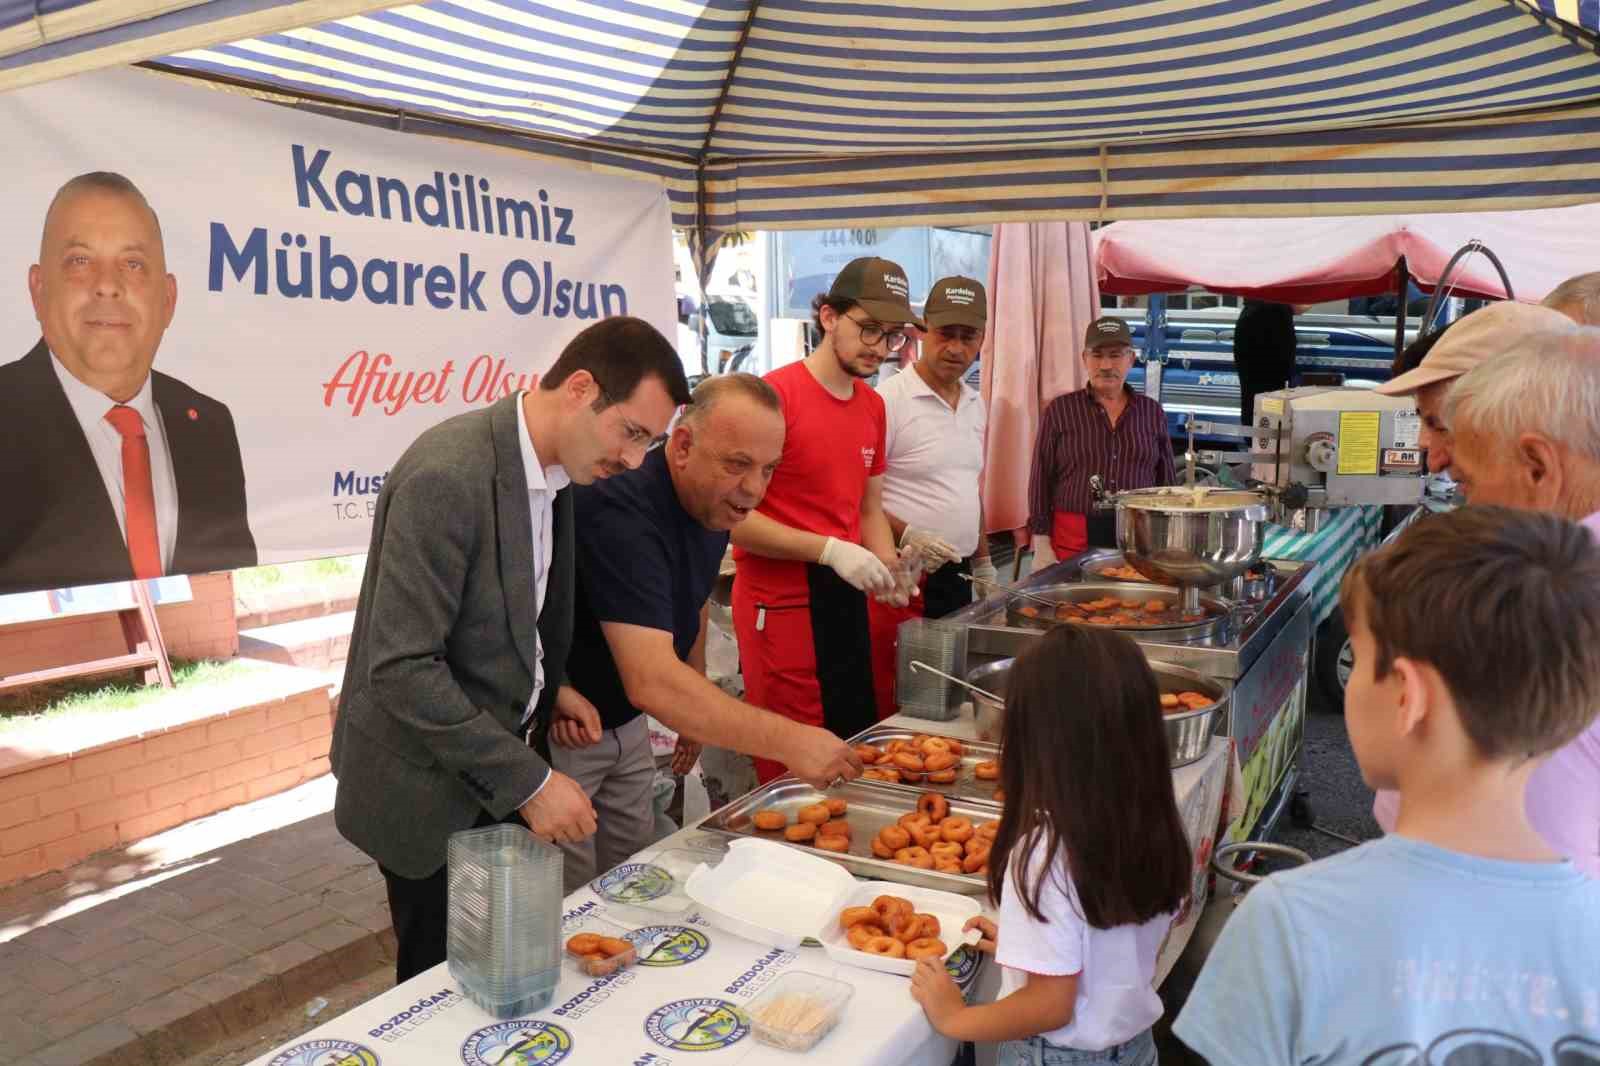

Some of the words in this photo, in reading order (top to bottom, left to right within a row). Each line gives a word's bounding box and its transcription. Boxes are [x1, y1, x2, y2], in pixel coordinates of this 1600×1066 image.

[291, 144, 576, 246] Kandilimiz
[207, 221, 488, 312] Mübarek
[501, 258, 629, 320] Olsun
[322, 350, 455, 417] Afiyet
[462, 354, 546, 404] Olsu
[333, 470, 389, 497] Mus
[332, 501, 363, 521] T.C.
[724, 947, 785, 995] BOZDOĞAN
[368, 988, 454, 1039] BOZDOĞAN
